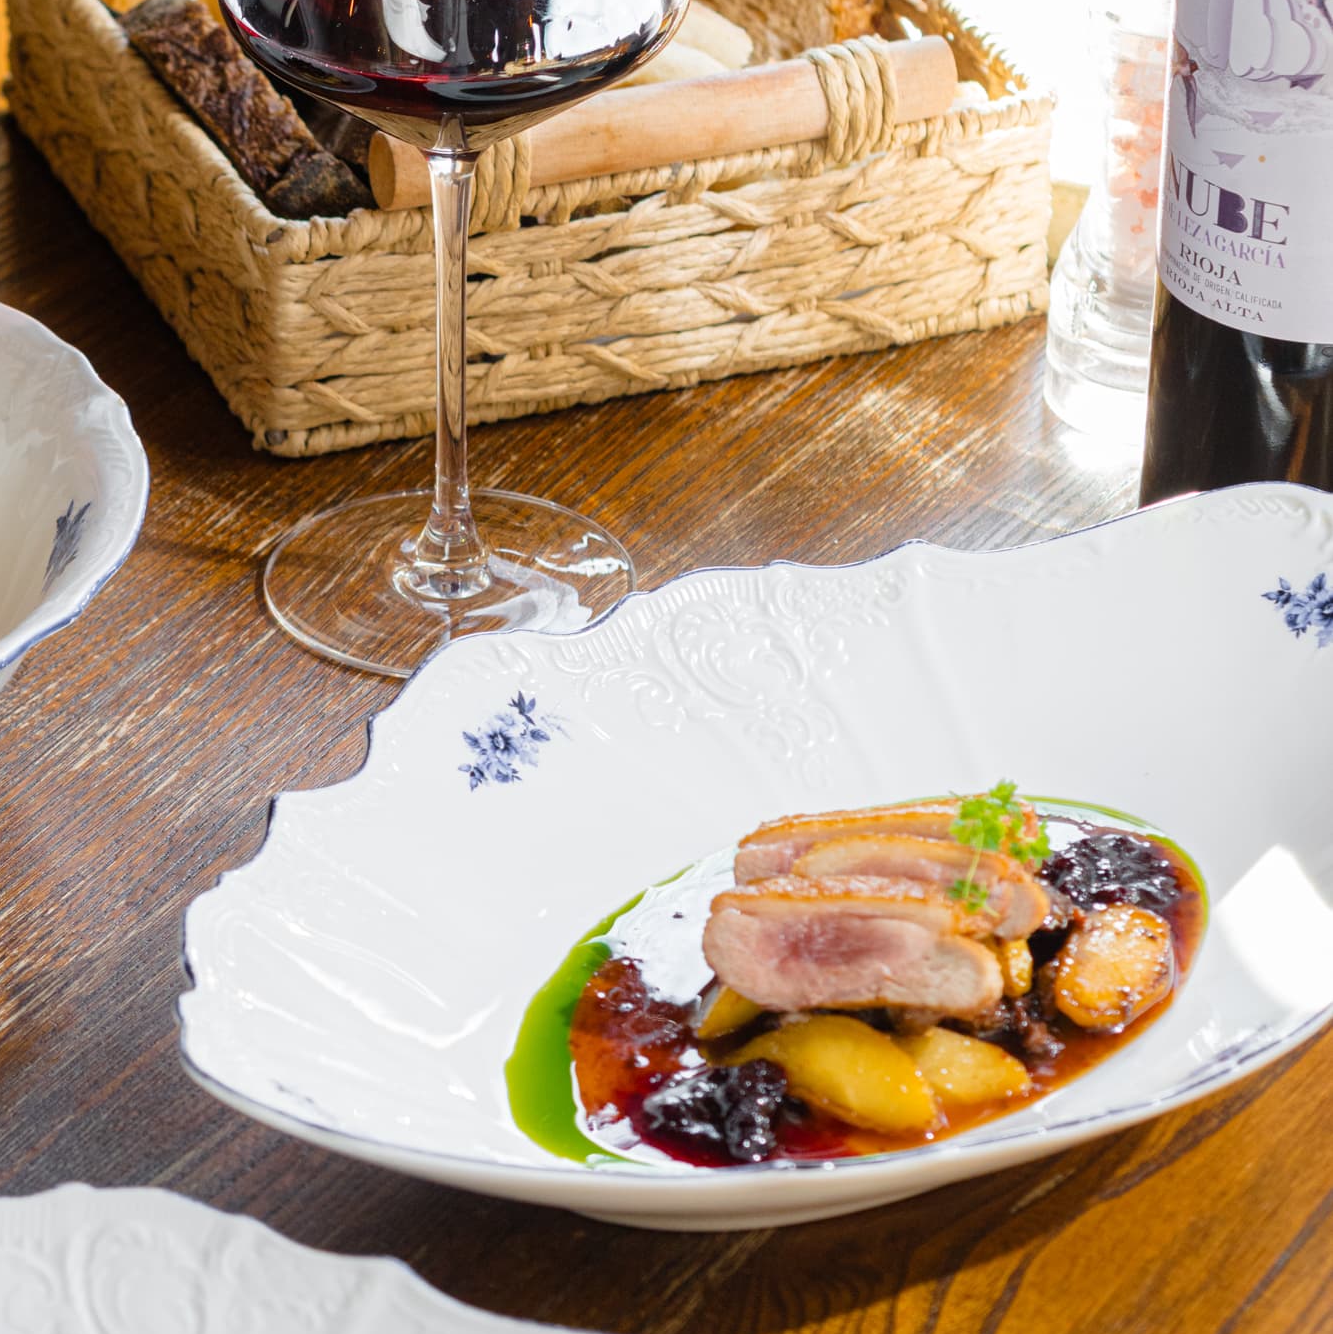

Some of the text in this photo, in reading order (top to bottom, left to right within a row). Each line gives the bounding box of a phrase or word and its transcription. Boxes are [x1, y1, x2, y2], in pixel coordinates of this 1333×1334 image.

[1168, 150, 1290, 246] NUBE
[1180, 242, 1242, 286] RIOJA
[1214, 232, 1286, 269] GARCÍA
[1166, 265, 1264, 323] RIOJA ALTA
[1193, 272, 1283, 310] DE ORIGEN CALIFICADA
